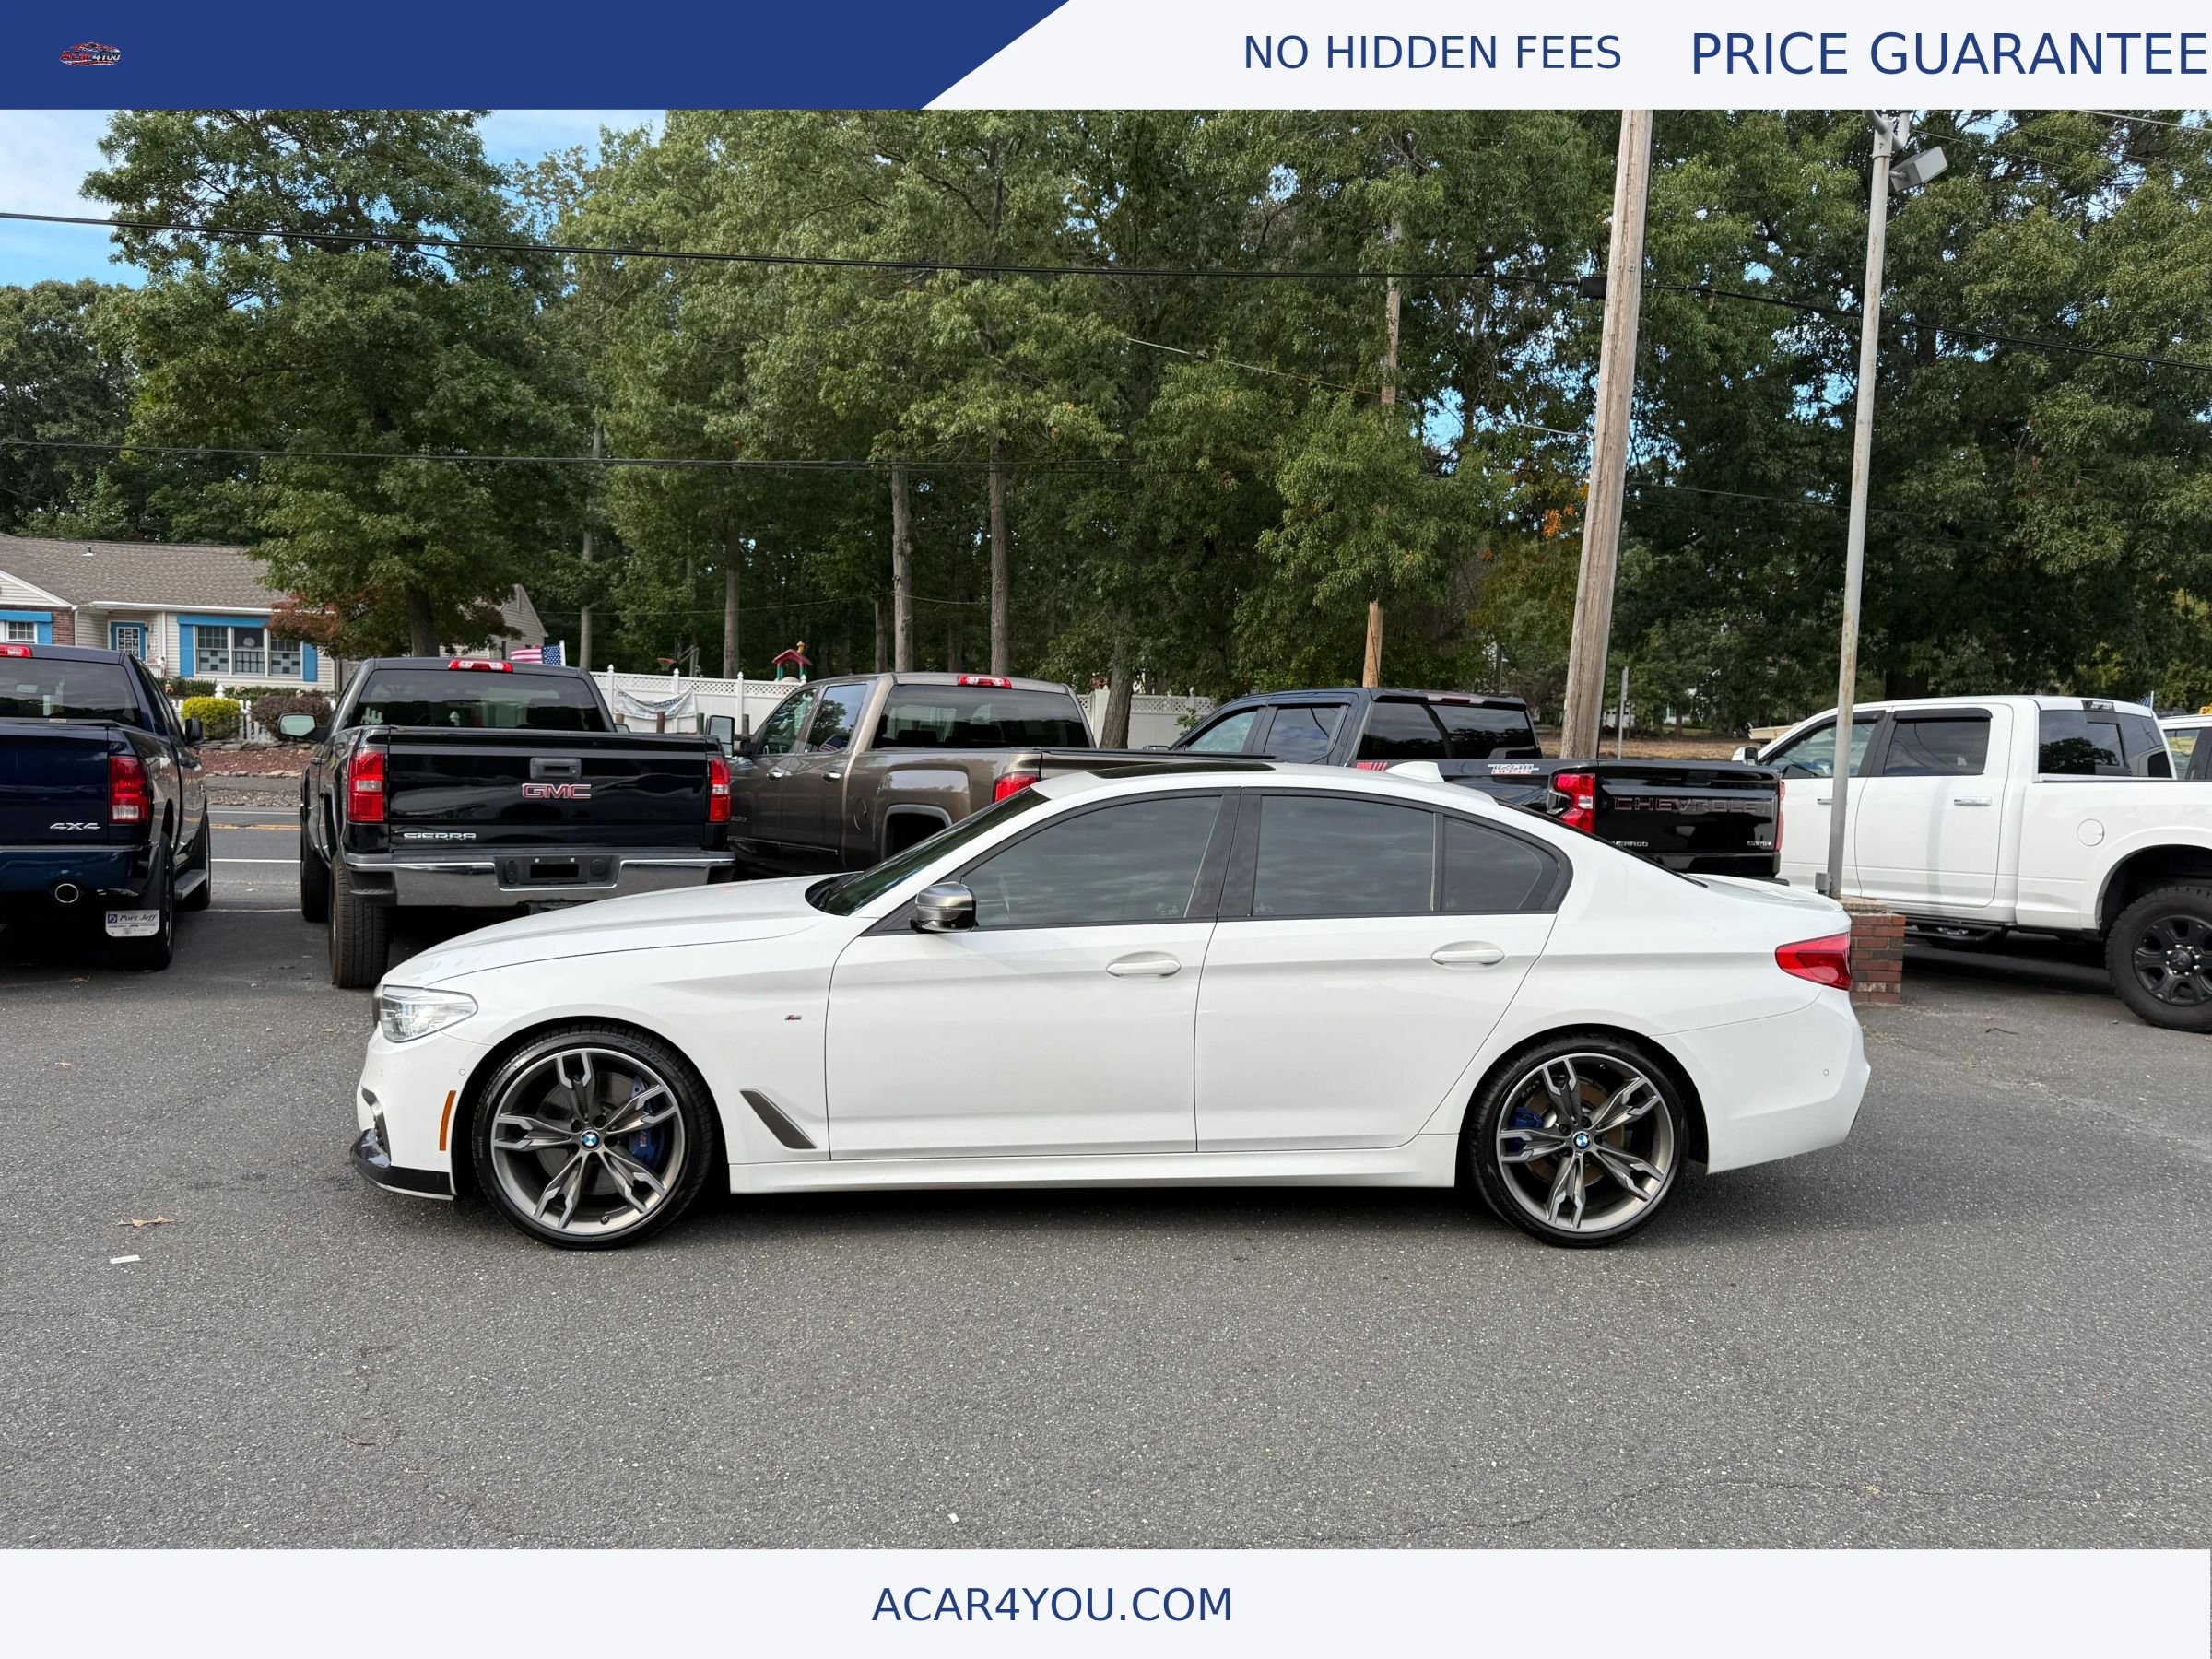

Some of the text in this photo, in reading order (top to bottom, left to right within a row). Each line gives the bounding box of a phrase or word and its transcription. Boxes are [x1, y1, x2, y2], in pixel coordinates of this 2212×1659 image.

[522, 783, 592, 799] GMC
[1614, 797, 1771, 813] CHEVROLET
[403, 832, 477, 841] SIERRA
